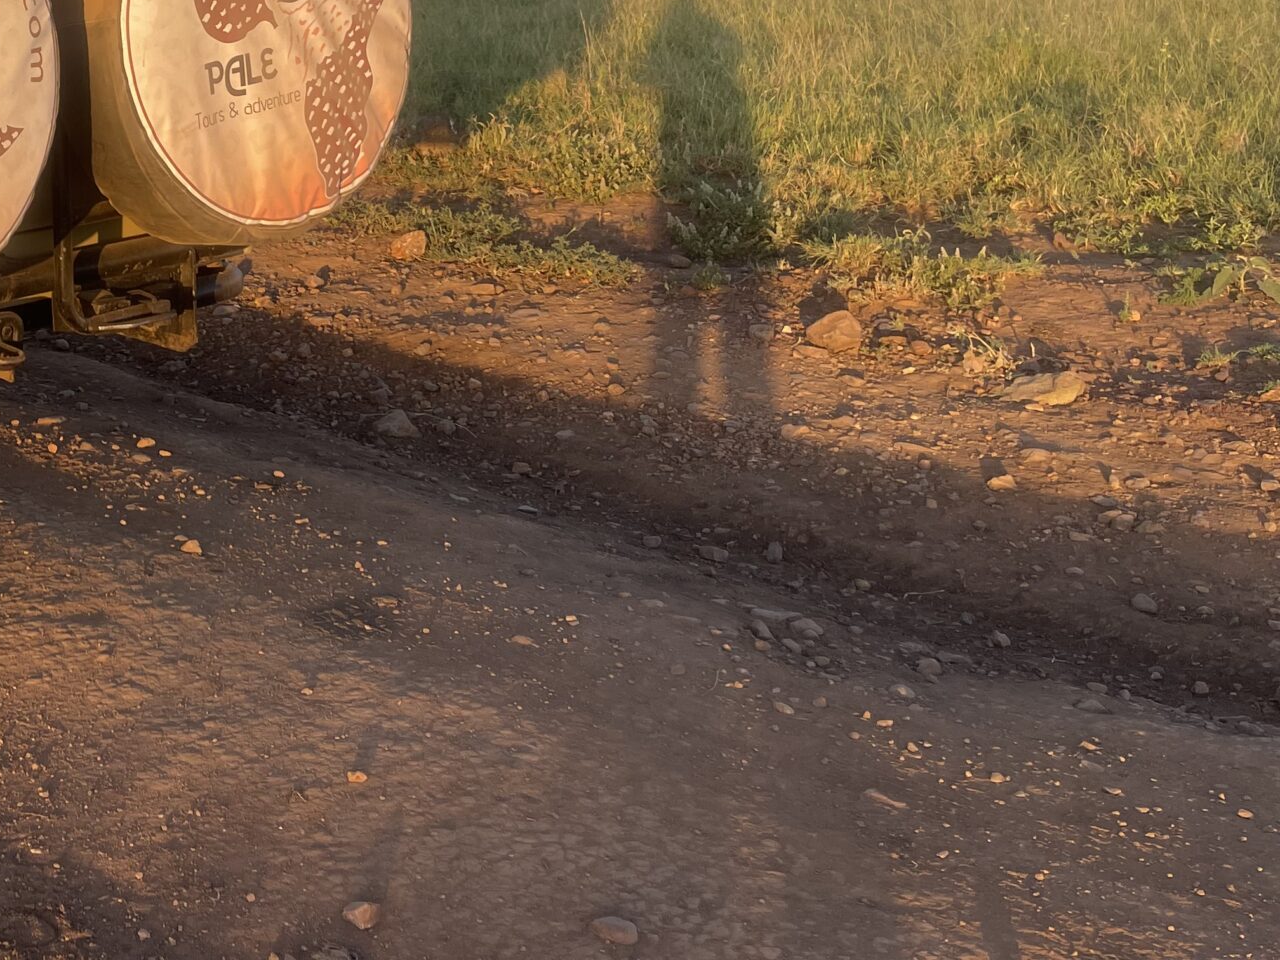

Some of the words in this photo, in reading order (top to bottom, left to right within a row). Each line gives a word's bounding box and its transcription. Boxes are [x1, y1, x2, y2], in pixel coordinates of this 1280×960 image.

[204, 47, 278, 97] PALE
[195, 106, 225, 130] Tours
[228, 101, 240, 117] &
[244, 89, 302, 116] adventure
